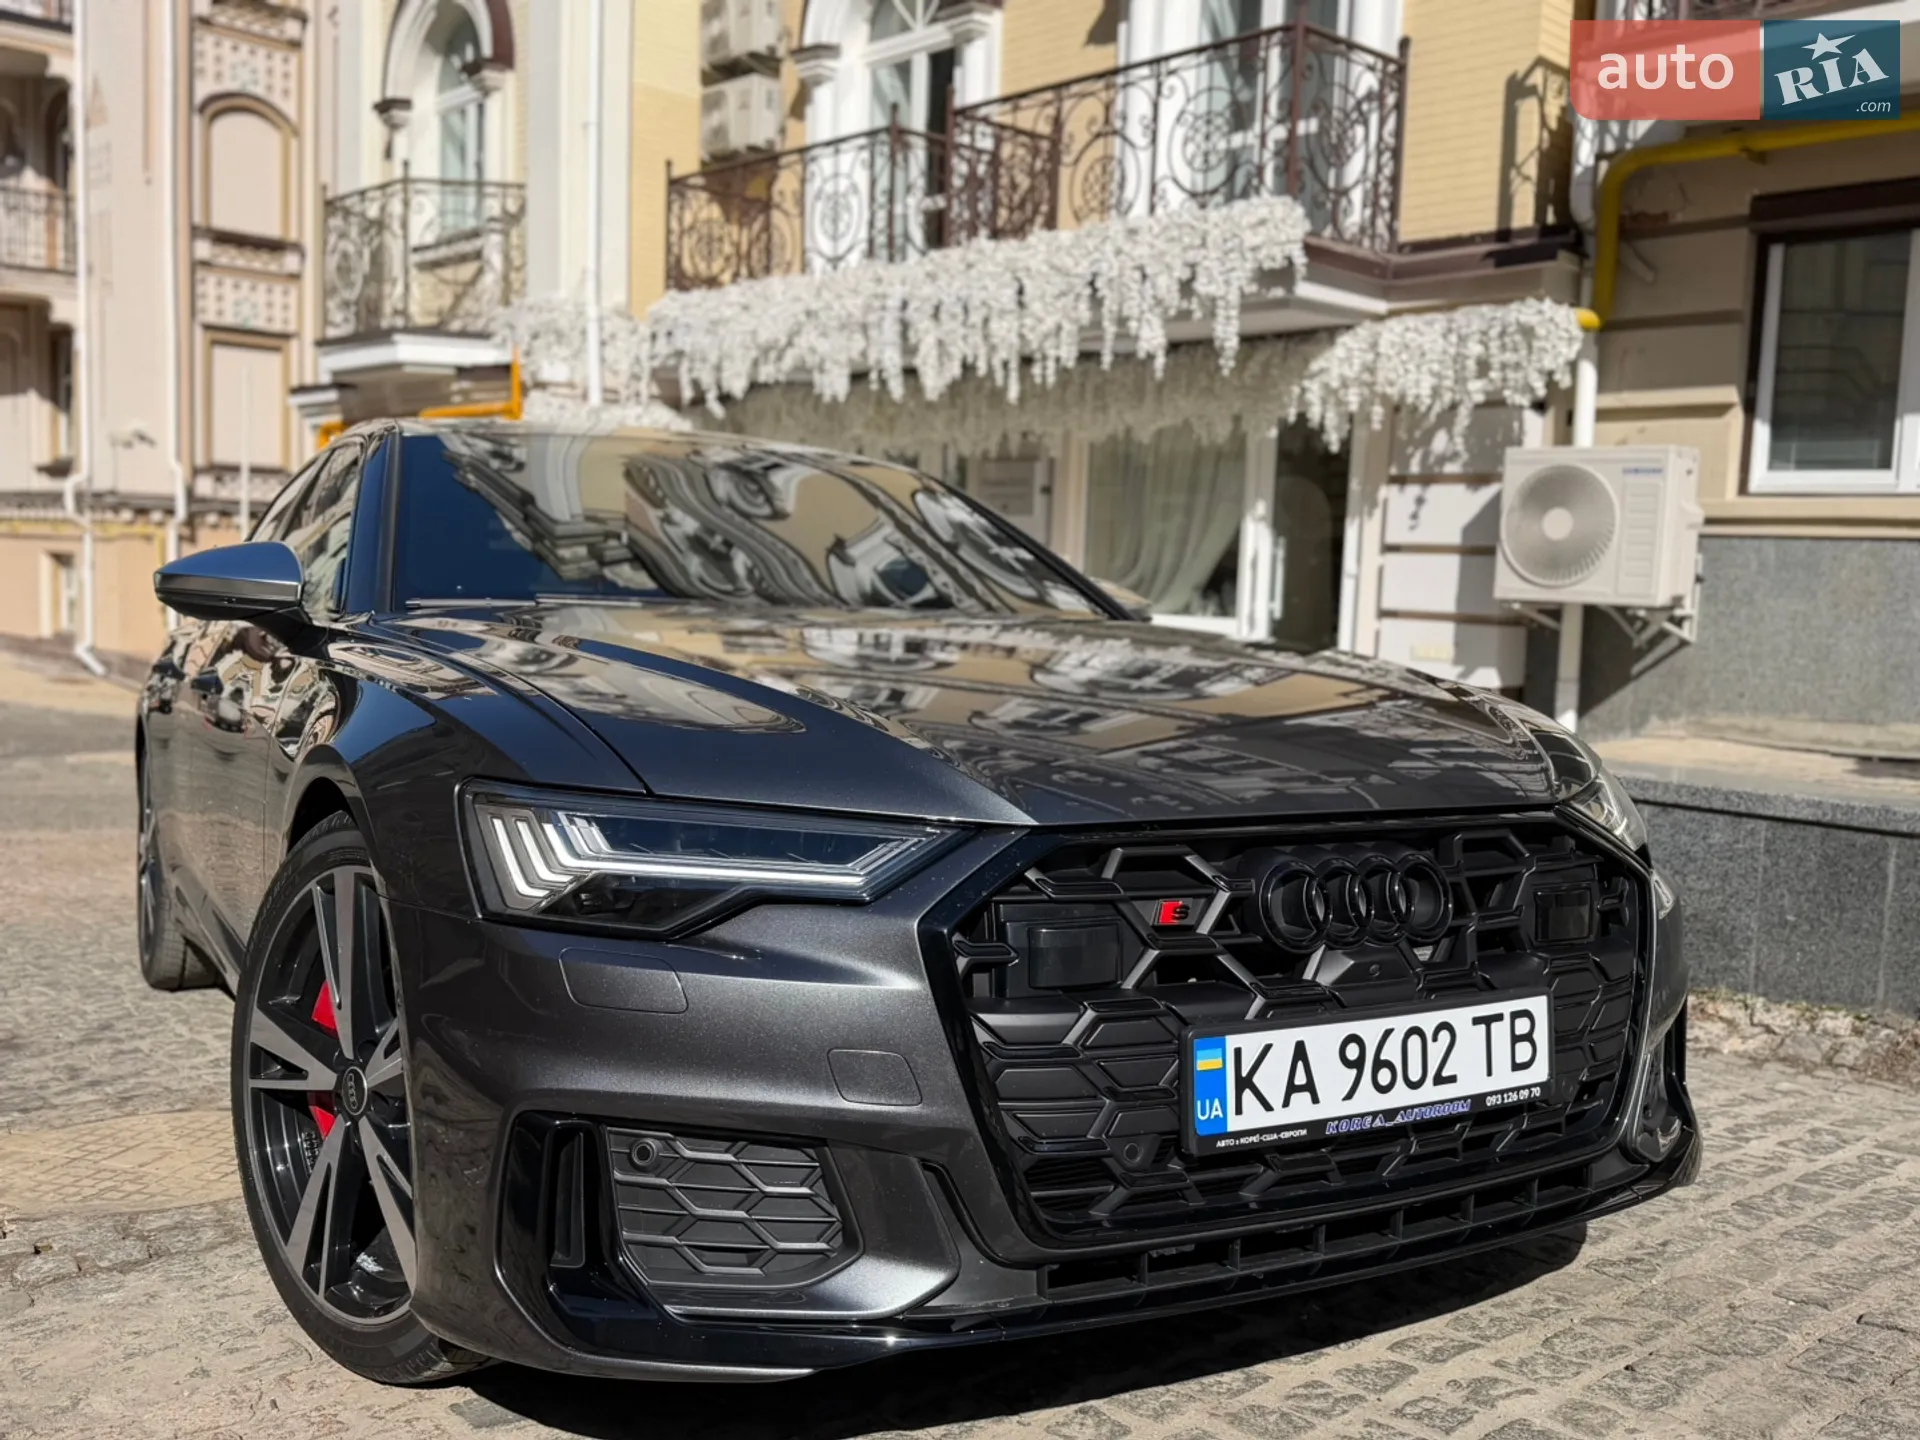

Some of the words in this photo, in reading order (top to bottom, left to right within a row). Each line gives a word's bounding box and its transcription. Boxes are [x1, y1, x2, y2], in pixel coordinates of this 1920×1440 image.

[1233, 1039, 1320, 1116] KA
[1338, 1021, 1458, 1101] 9602
[1471, 1008, 1538, 1078] TB
[1485, 1095, 1502, 1107] 093
[1503, 1090, 1518, 1104] 126
[1519, 1088, 1530, 1100] 09
[1530, 1086, 1541, 1099] 70
[1196, 1099, 1223, 1121] UA
